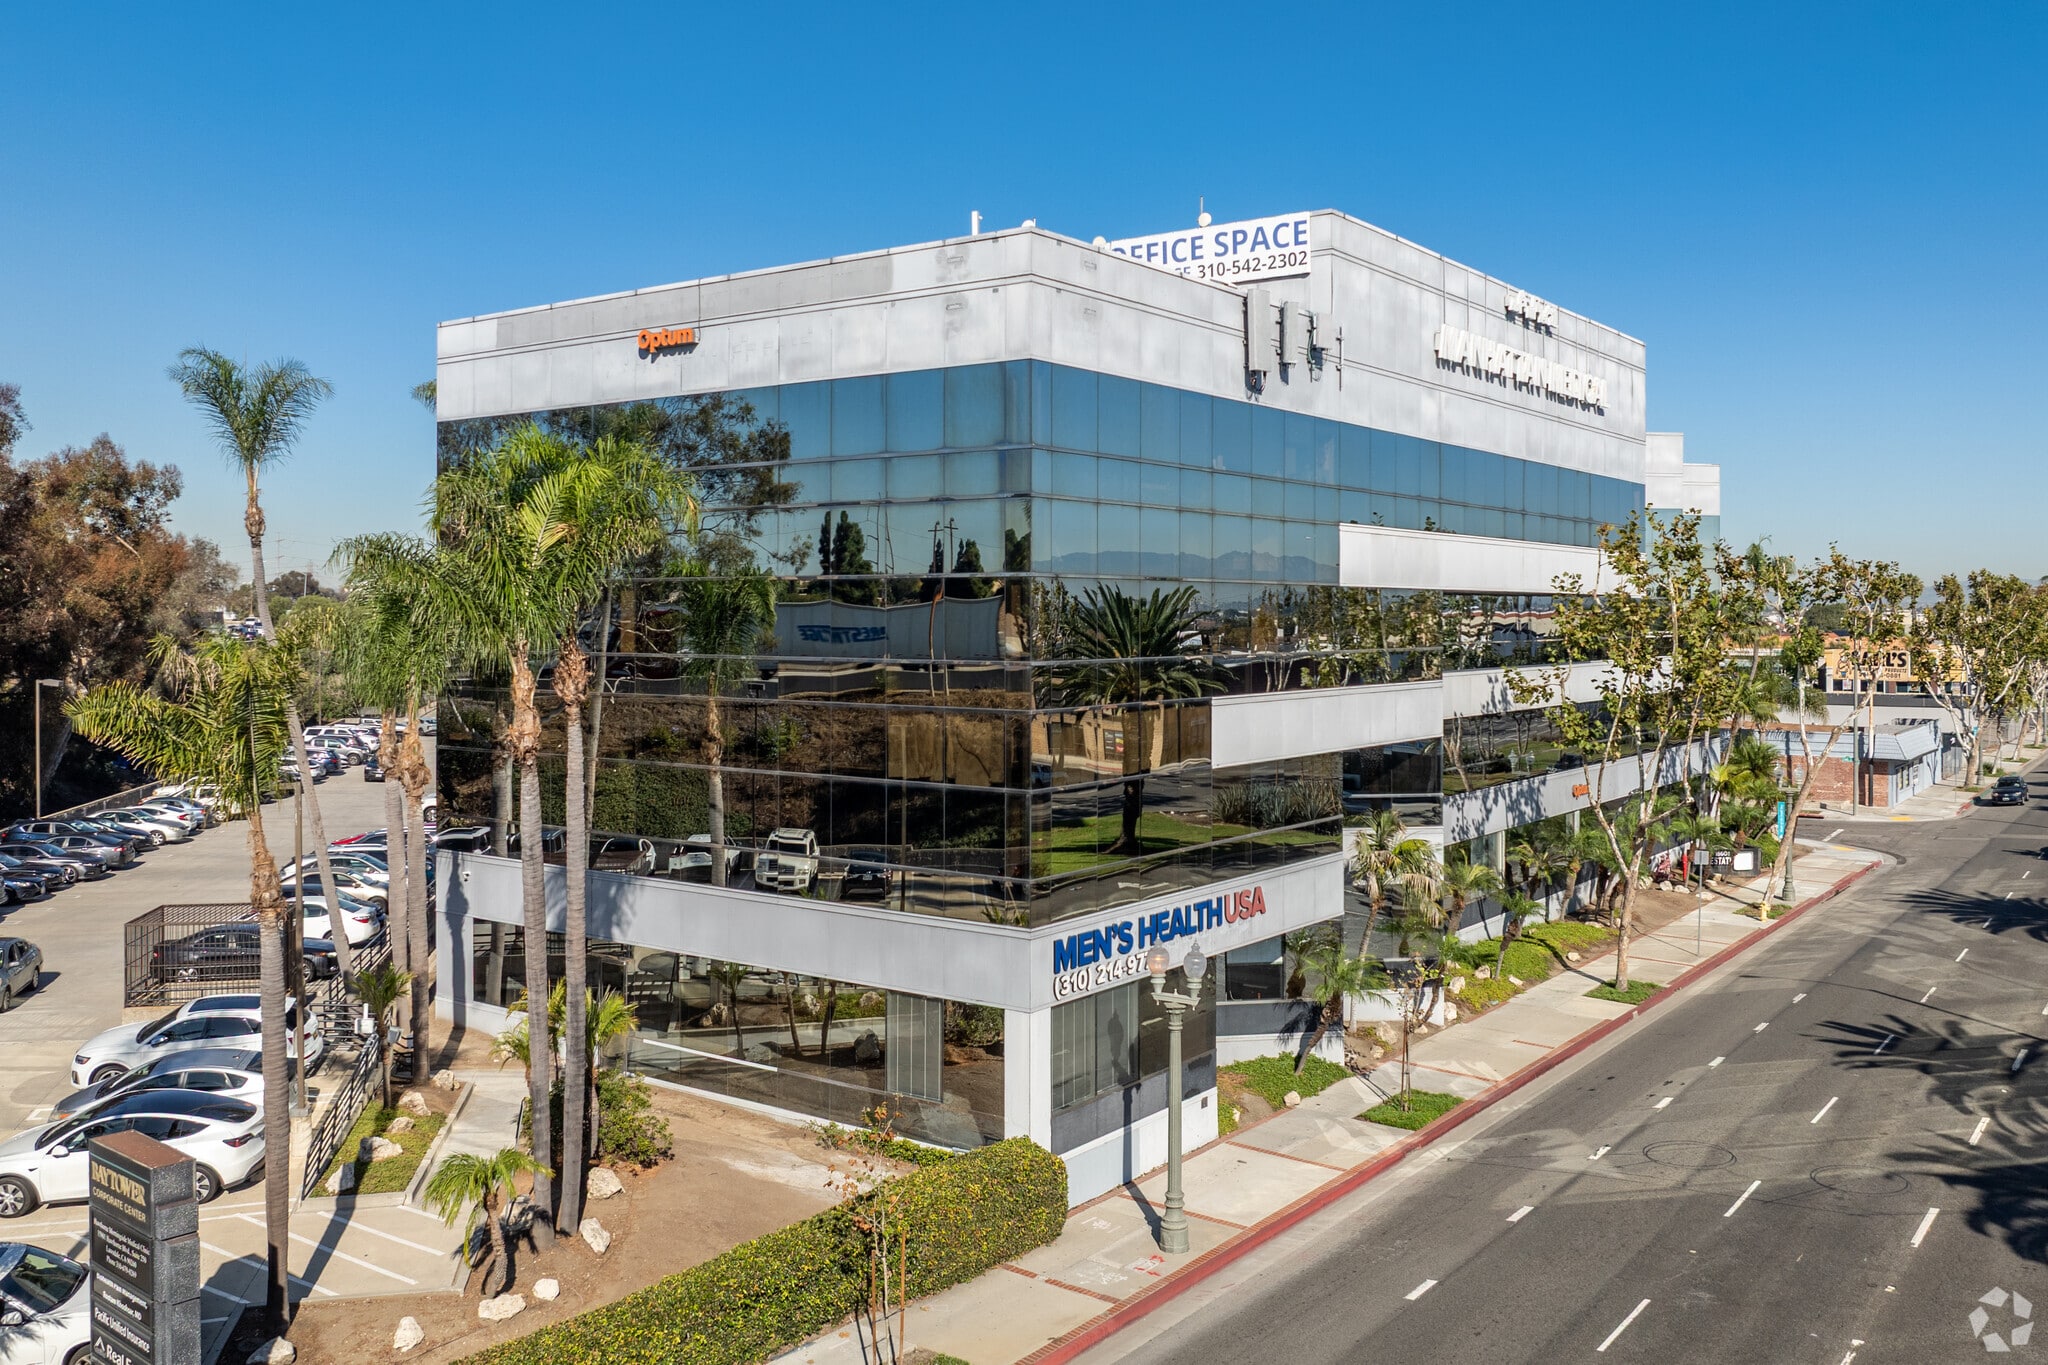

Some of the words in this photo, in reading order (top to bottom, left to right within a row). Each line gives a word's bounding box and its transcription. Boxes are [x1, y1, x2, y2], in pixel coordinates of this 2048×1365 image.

[1214, 219, 1308, 257] SPACE
[1198, 250, 1308, 279] 310-542-2302
[637, 327, 694, 353] Optum
[1053, 920, 1134, 975] MEN'S
[1053, 966, 1092, 1001] (310)
[93, 1186, 124, 1211] CORPORATE
[123, 1203, 147, 1223] CENTER
[106, 1344, 125, 1365] Real
